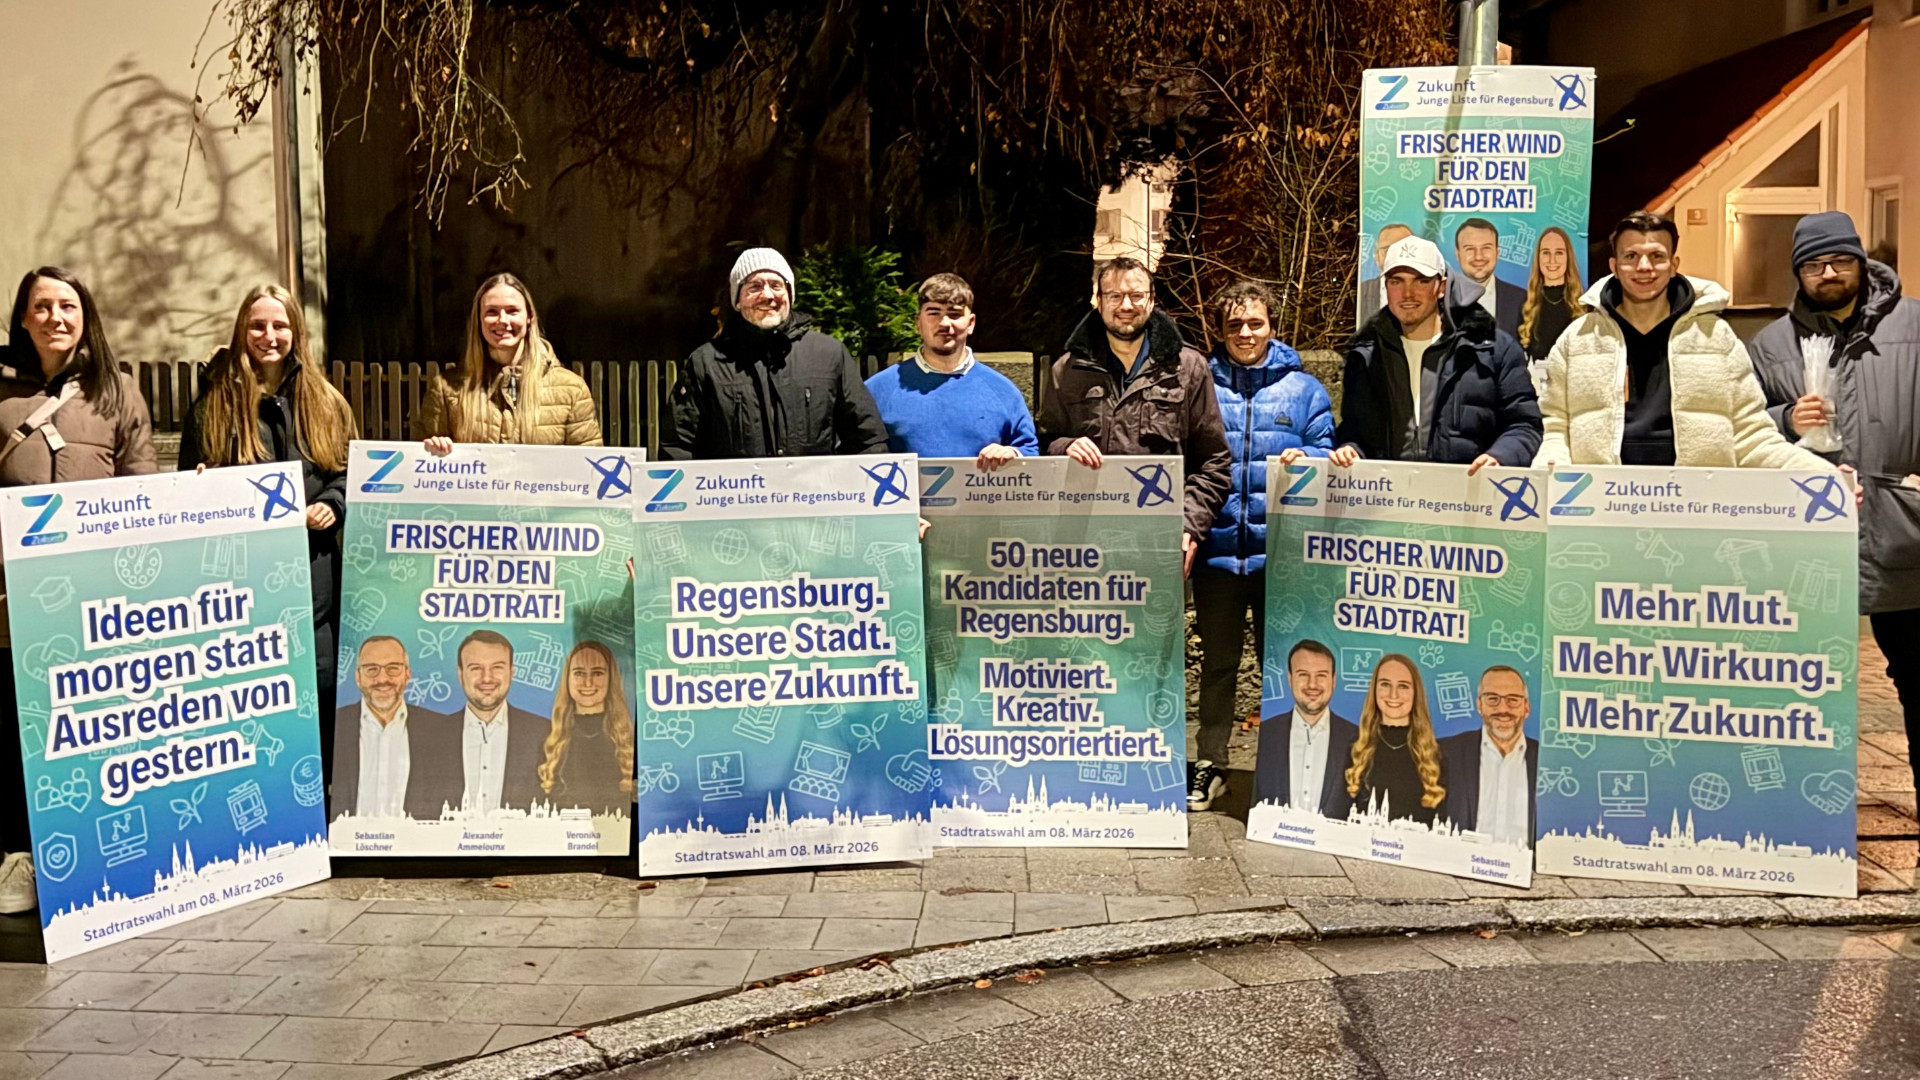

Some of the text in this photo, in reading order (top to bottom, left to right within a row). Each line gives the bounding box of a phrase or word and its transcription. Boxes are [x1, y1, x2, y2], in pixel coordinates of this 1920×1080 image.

[1417, 81, 1475, 92] Zukunft
[1417, 95, 1554, 107] Junge Liste für Regensburg
[1401, 134, 1561, 154] FRISCHER WIND
[1439, 157, 1526, 181] FÜR DEN
[1428, 189, 1533, 208] STADTRAT!
[415, 460, 486, 475] Zukunft
[414, 479, 589, 495] Junge Liste für Regensburg
[696, 475, 765, 490] Zukunft
[965, 473, 1032, 488] Zukunft
[1327, 475, 1393, 492] Zukunft
[1605, 481, 1682, 497] Zukunft
[76, 496, 151, 516] Zukunft
[696, 490, 866, 507] Junge Liste für Regensburg
[965, 490, 1130, 504] Junge Liste für Regensburg
[1327, 494, 1493, 516] Junge Liste für Regensburg
[77, 504, 256, 536] Junge Liste für Regensburg
[1604, 501, 1796, 518] Junge Liste für Regensburg
[391, 524, 599, 552] FRISCHER WIND
[991, 541, 1099, 568] 50 neue
[1308, 535, 1504, 574] FRISCHER WIND
[438, 553, 550, 584] FÜR DEN
[945, 574, 1147, 601] Kandidaten für
[1350, 566, 1455, 604] FÜR DEN
[424, 592, 560, 619] STADTRAT!
[677, 579, 884, 618] Regensburg.
[1601, 587, 1792, 625] Mehr Mut.
[88, 588, 249, 643] Ideen für
[961, 607, 1130, 640] Regensburg.
[1338, 604, 1465, 638] STADTRAT!
[672, 621, 891, 659] Unsere Stadt.
[56, 630, 282, 700] morgen statt
[984, 661, 1112, 689] Motiviert.
[1559, 642, 1835, 690] Mehr Wirkung.
[651, 667, 913, 706] Unsere Zukunft.
[52, 679, 291, 753] Ausreden von
[998, 695, 1099, 722] Kreativ.
[1566, 697, 1827, 741] Mehr Zukunft.
[108, 737, 250, 799] gestern.
[355, 832, 394, 840] Sebastian
[463, 831, 503, 840] Alexander
[566, 831, 601, 839] Veronika
[940, 826, 1134, 839] Stadtratswahl am 08. März 2026
[1278, 822, 1315, 835] Alexander
[356, 842, 392, 851] Löschner
[568, 842, 599, 850] Brandel
[675, 842, 879, 864] Stadtratswahl am 08. März 2026
[1371, 838, 1404, 850] Veronika
[1371, 849, 1402, 861] Brandel
[1471, 855, 1511, 869] Sebastian
[1471, 866, 1508, 879] Löschner
[1573, 855, 1795, 883] Stadtratswahl am 08. März 2026
[83, 873, 284, 942] Stadtratswahl am 08. März 2026
